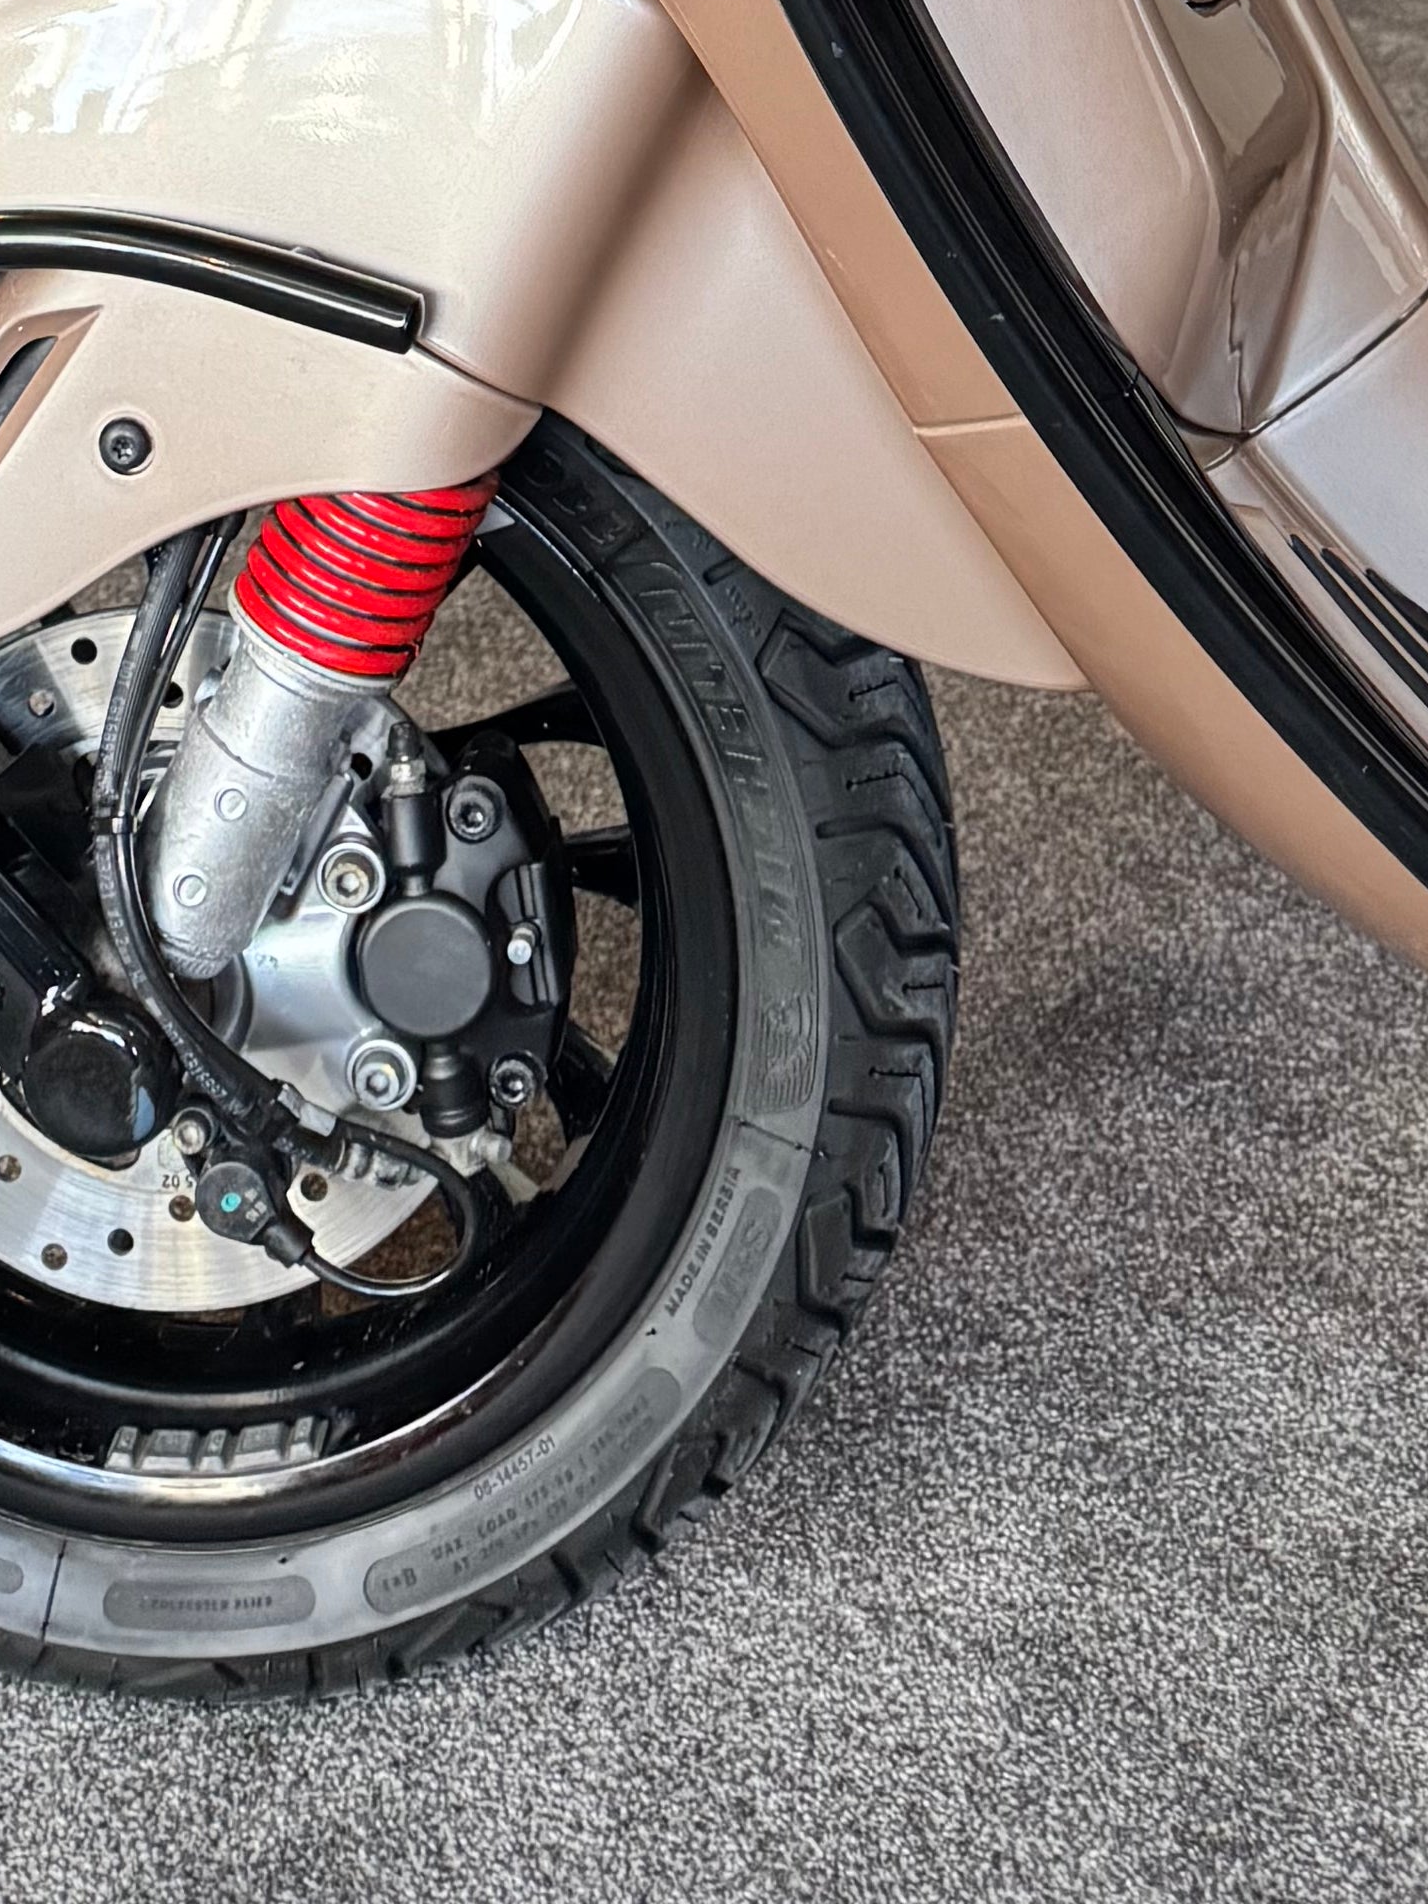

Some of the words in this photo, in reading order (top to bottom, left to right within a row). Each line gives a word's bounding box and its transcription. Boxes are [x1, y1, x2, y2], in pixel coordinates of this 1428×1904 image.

[664, 1259, 704, 1317] MADE
[695, 1235, 713, 1266] IN
[707, 1166, 741, 1237] SERBIA
